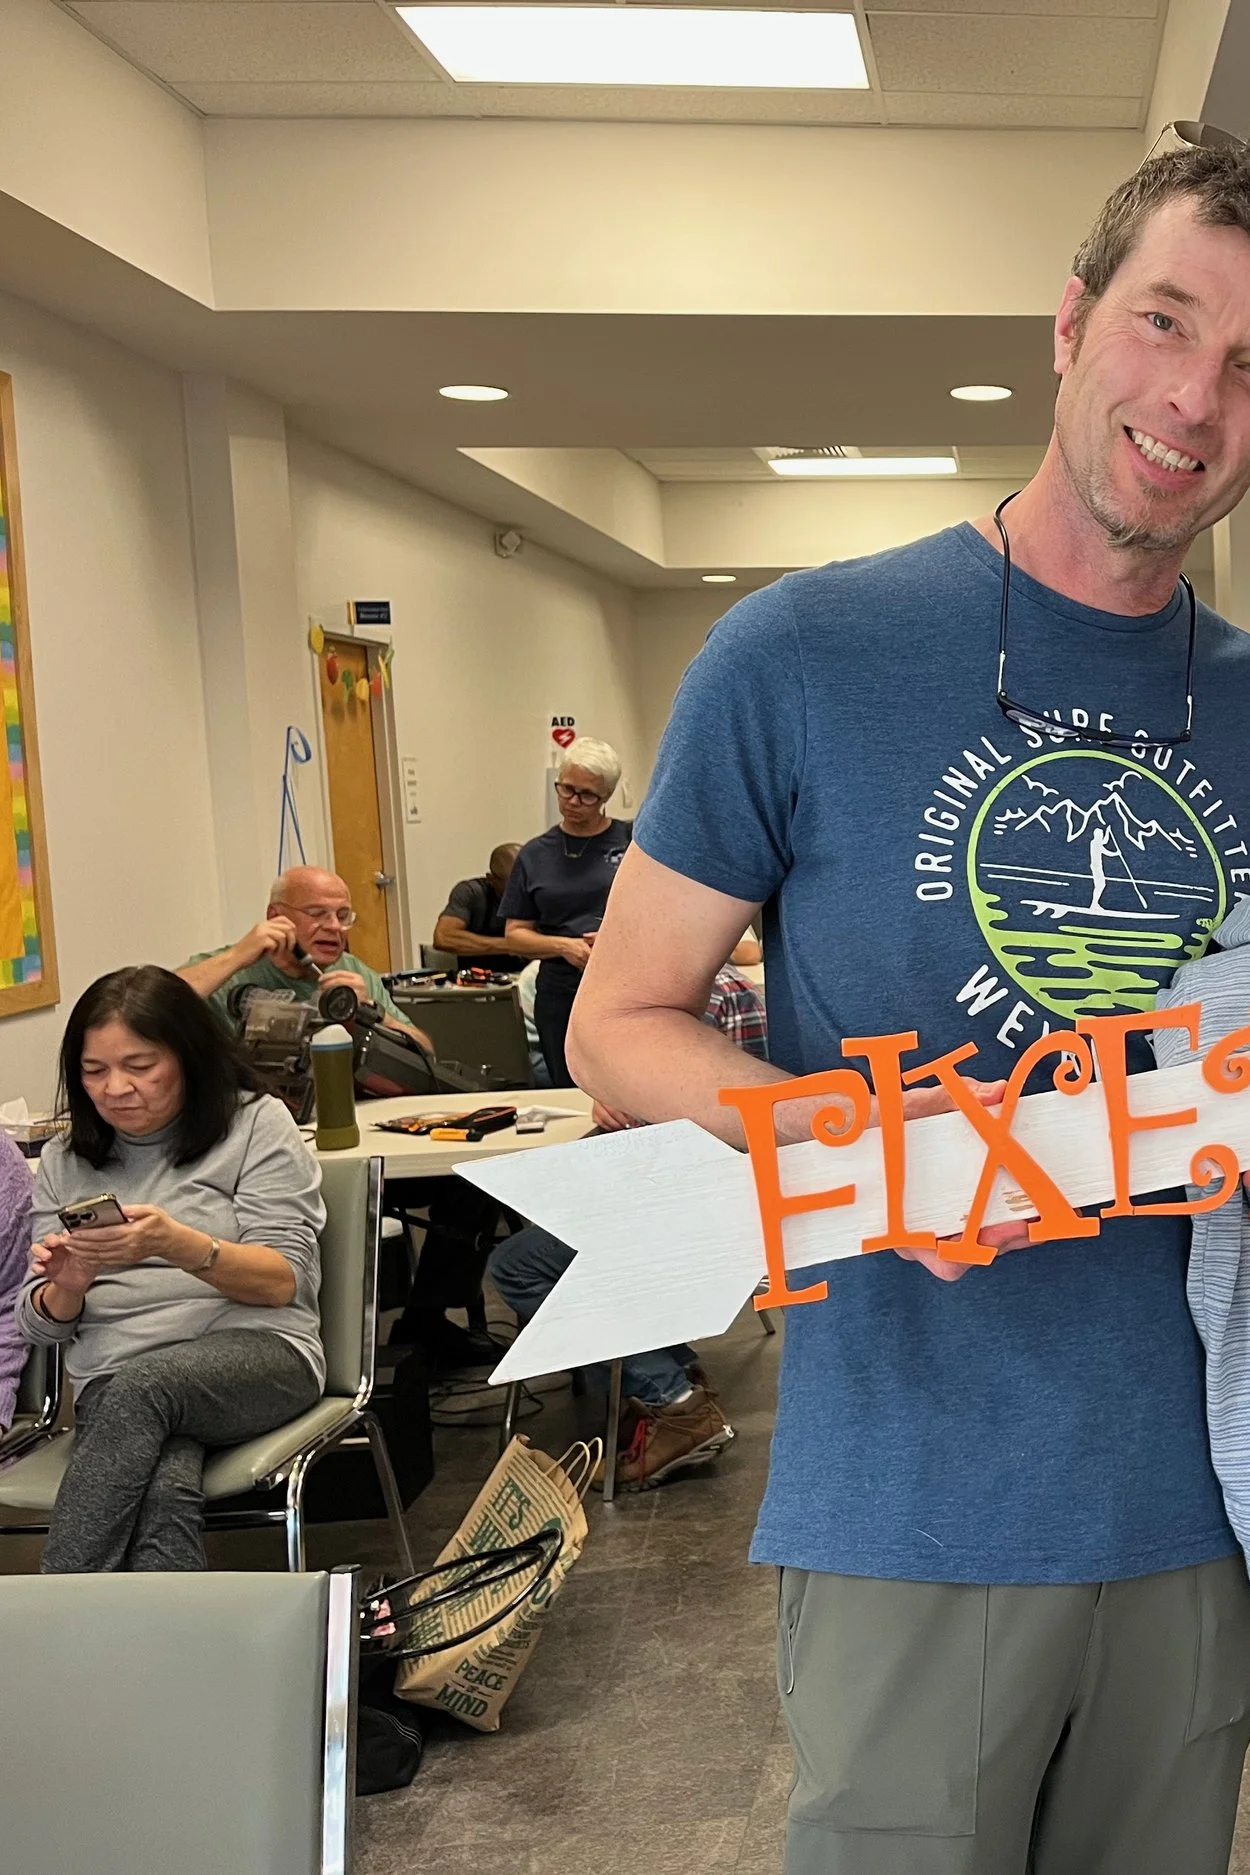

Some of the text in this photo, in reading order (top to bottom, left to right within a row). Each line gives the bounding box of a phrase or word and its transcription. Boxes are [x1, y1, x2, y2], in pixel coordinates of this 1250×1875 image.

[552, 716, 575, 727] AED
[914, 736, 1012, 902] ORIGINAL
[455, 1658, 508, 1690] PEACE
[434, 1682, 489, 1717] MIND
